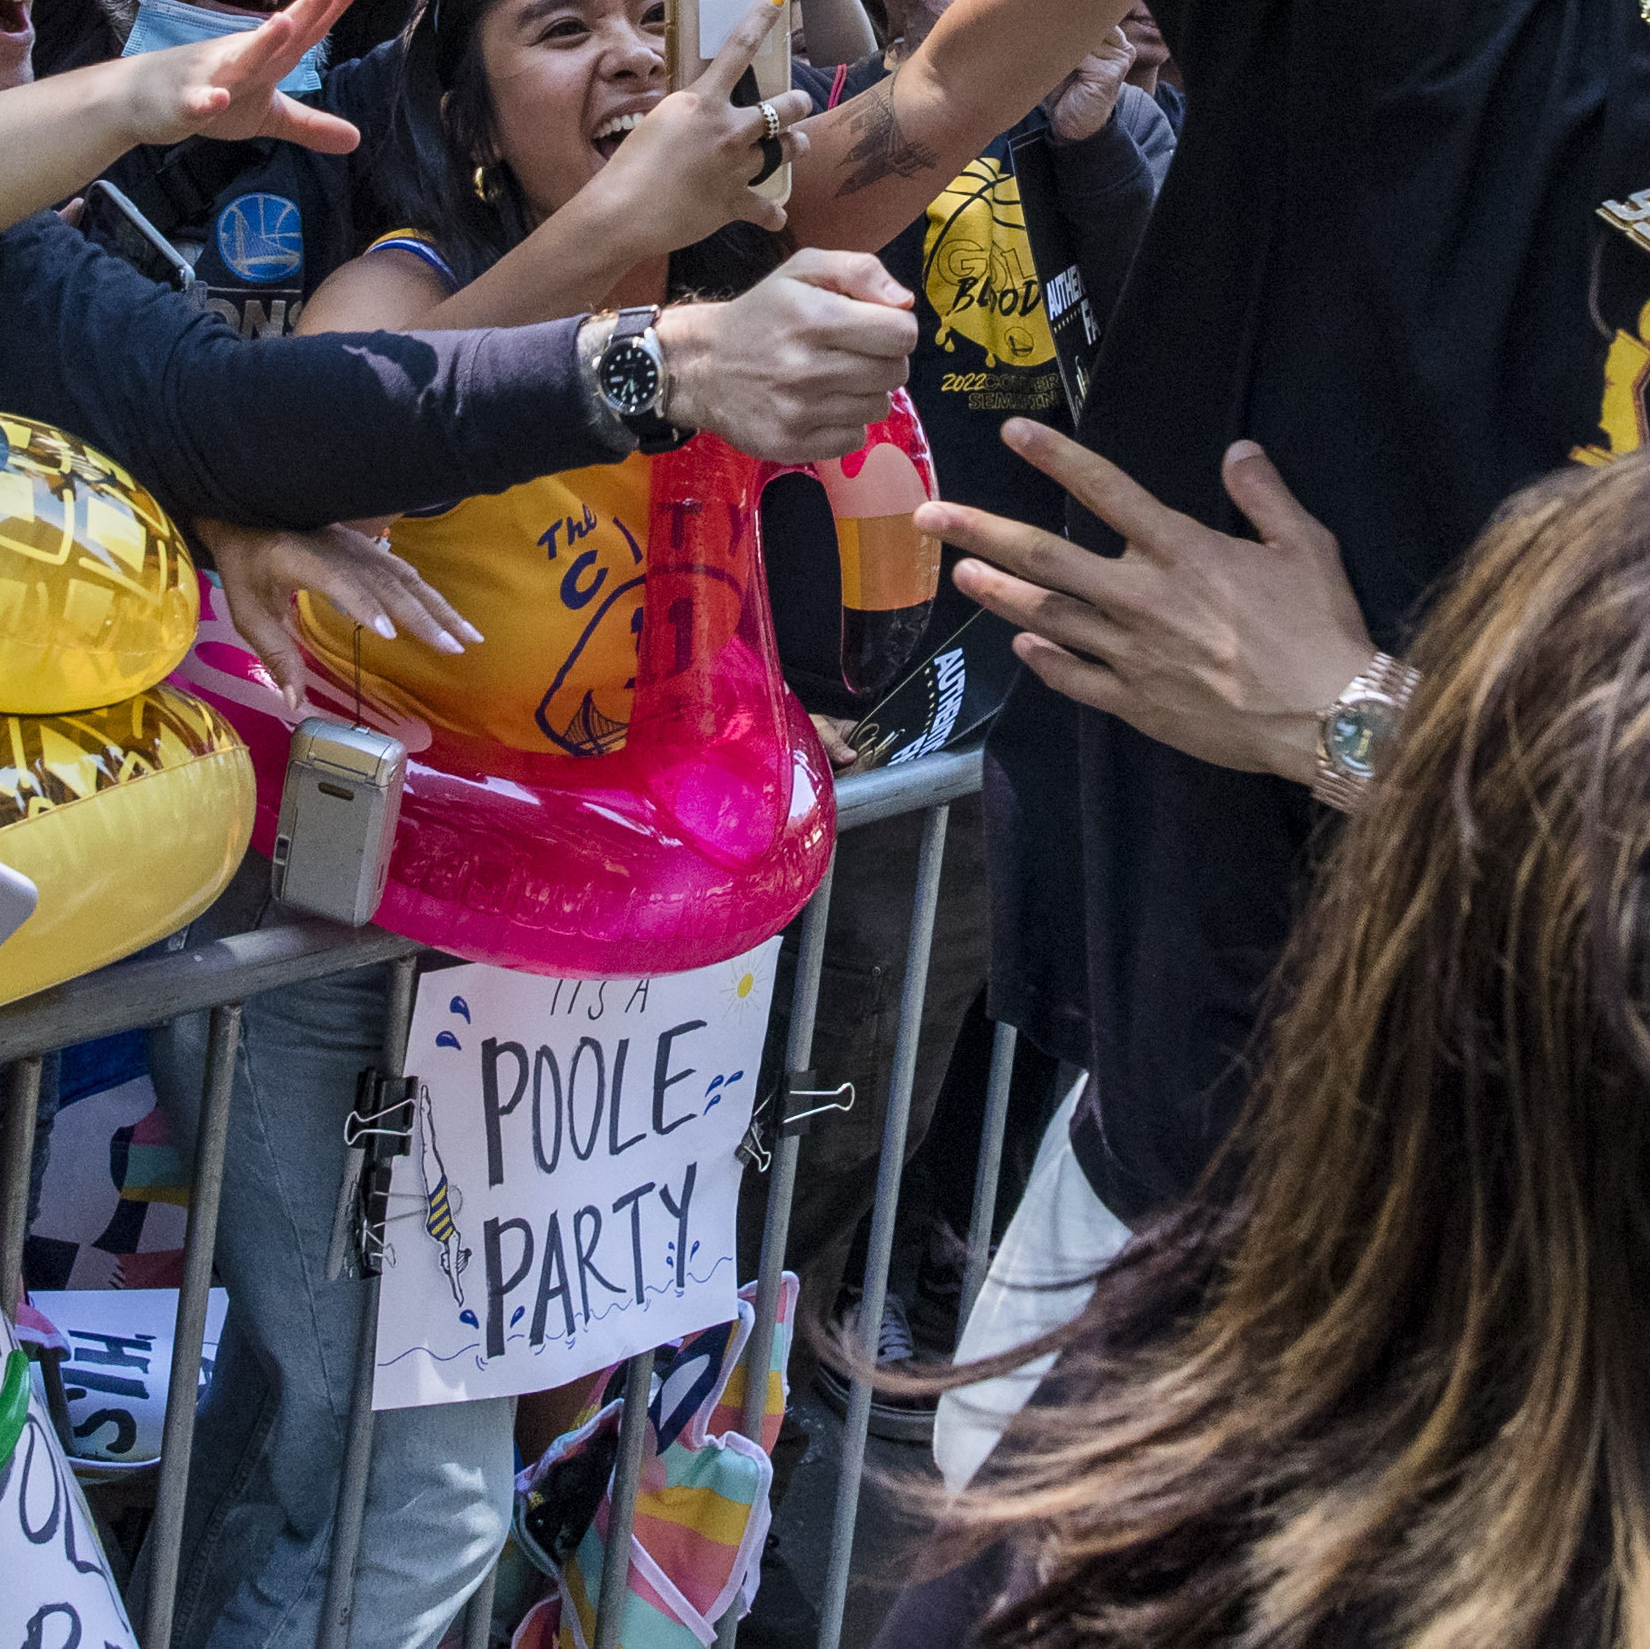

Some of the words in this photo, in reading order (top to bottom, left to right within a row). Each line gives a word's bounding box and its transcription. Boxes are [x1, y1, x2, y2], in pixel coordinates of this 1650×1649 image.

[941, 372, 987, 392] 2022
[480, 1018, 708, 1189] POOLE
[484, 1161, 700, 1359] PARTY
